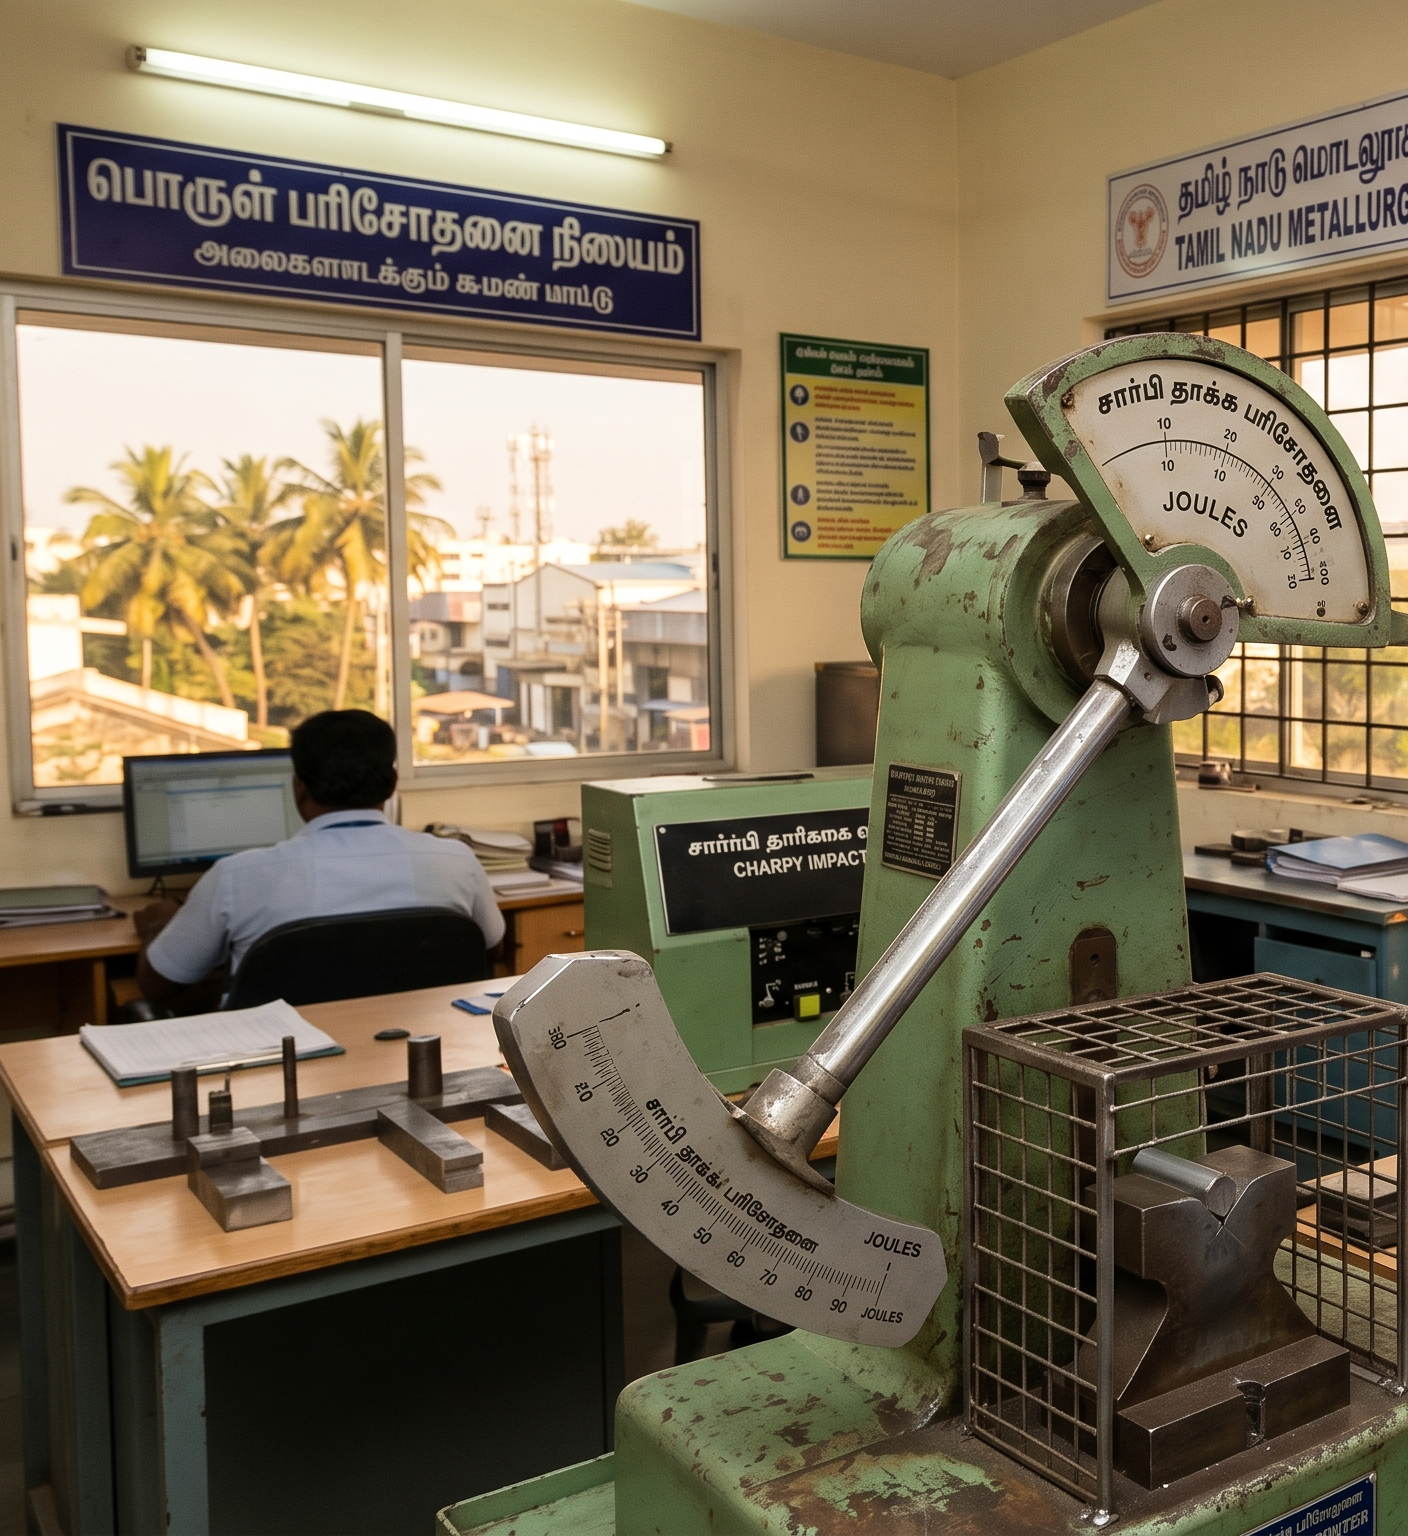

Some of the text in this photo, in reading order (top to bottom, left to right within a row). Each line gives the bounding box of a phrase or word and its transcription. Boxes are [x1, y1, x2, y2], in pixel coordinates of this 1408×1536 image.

[87, 157, 277, 228] பொருள்
[289, 183, 543, 257] பரிசோதனை
[1178, 156, 1232, 225] தமிழ்
[1237, 148, 1286, 211] நாடு
[1175, 227, 1225, 271] TAMIL
[1231, 212, 1282, 260] NADU
[1098, 374, 1164, 415] சார்பி
[1170, 381, 1238, 413] தாக்க
[1156, 417, 1172, 430] 10
[1223, 429, 1238, 443] 20
[1161, 460, 1175, 472] 10
[1213, 469, 1226, 482] 10
[1163, 491, 1248, 538] JOULES
[733, 856, 803, 878] CHARPY
[808, 849, 867, 871] IMPACT
[600, 1127, 620, 1148] 20
[629, 1165, 649, 1184] 30
[661, 1199, 680, 1216] 40
[693, 1226, 712, 1245] 50
[726, 1250, 745, 1268] 60
[759, 1268, 778, 1287] 70
[794, 1285, 813, 1302] 80
[829, 1299, 848, 1314] 90
[860, 1306, 904, 1324] JOULES
[863, 1231, 923, 1258] JOULES
